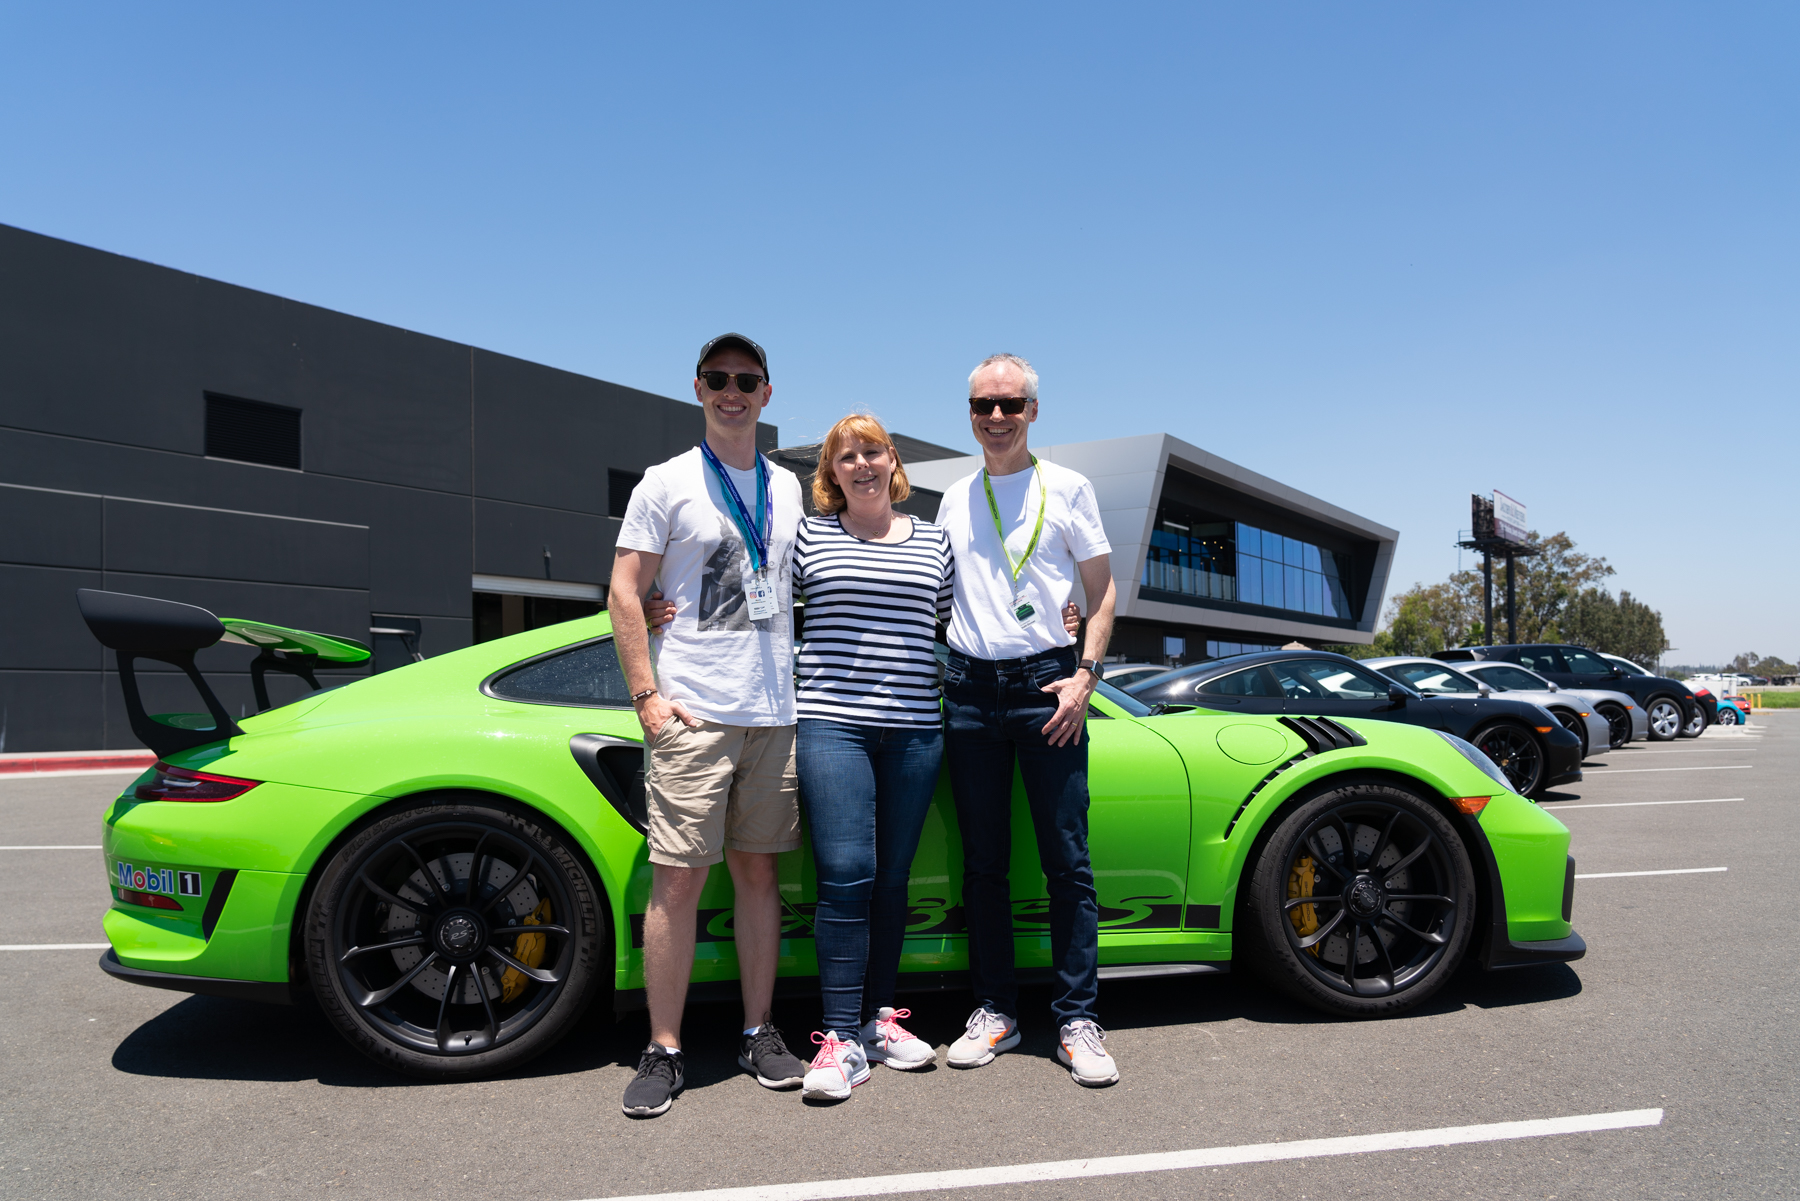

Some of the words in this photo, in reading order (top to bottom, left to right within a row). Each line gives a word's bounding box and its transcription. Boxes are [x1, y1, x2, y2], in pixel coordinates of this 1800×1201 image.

[1382, 786, 1442, 822] MICHELIN
[117, 861, 174, 895] Mobil
[551, 845, 597, 936] MICHELIN
[310, 941, 358, 1036] MICHELIN
